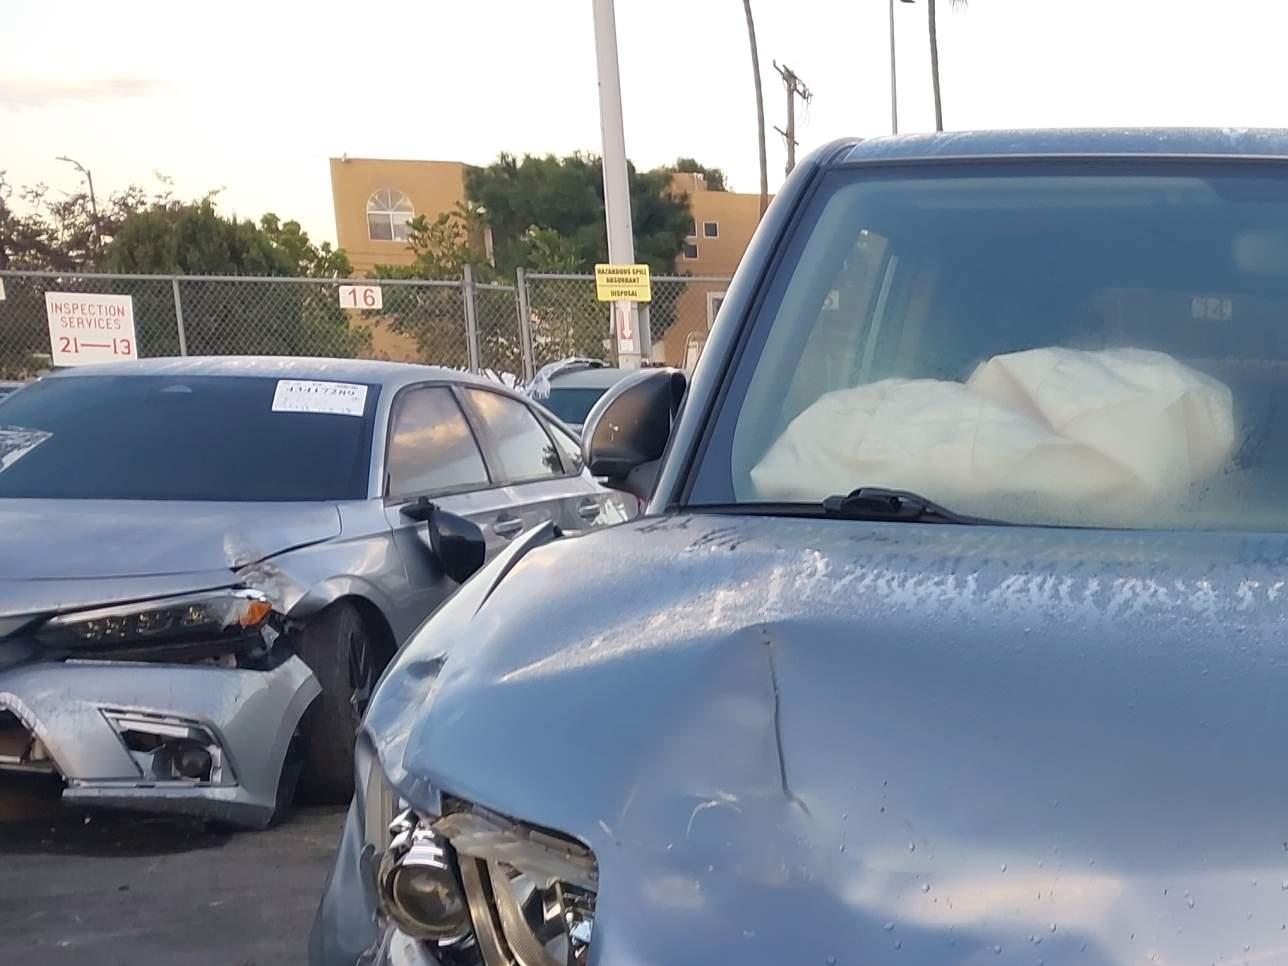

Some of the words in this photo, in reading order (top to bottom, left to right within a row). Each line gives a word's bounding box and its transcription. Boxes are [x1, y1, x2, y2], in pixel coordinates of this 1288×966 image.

[348, 287, 376, 307] 16
[610, 289, 638, 297] DISPOSAL
[50, 302, 126, 317] INSPECTION
[60, 316, 122, 330] SERVICES
